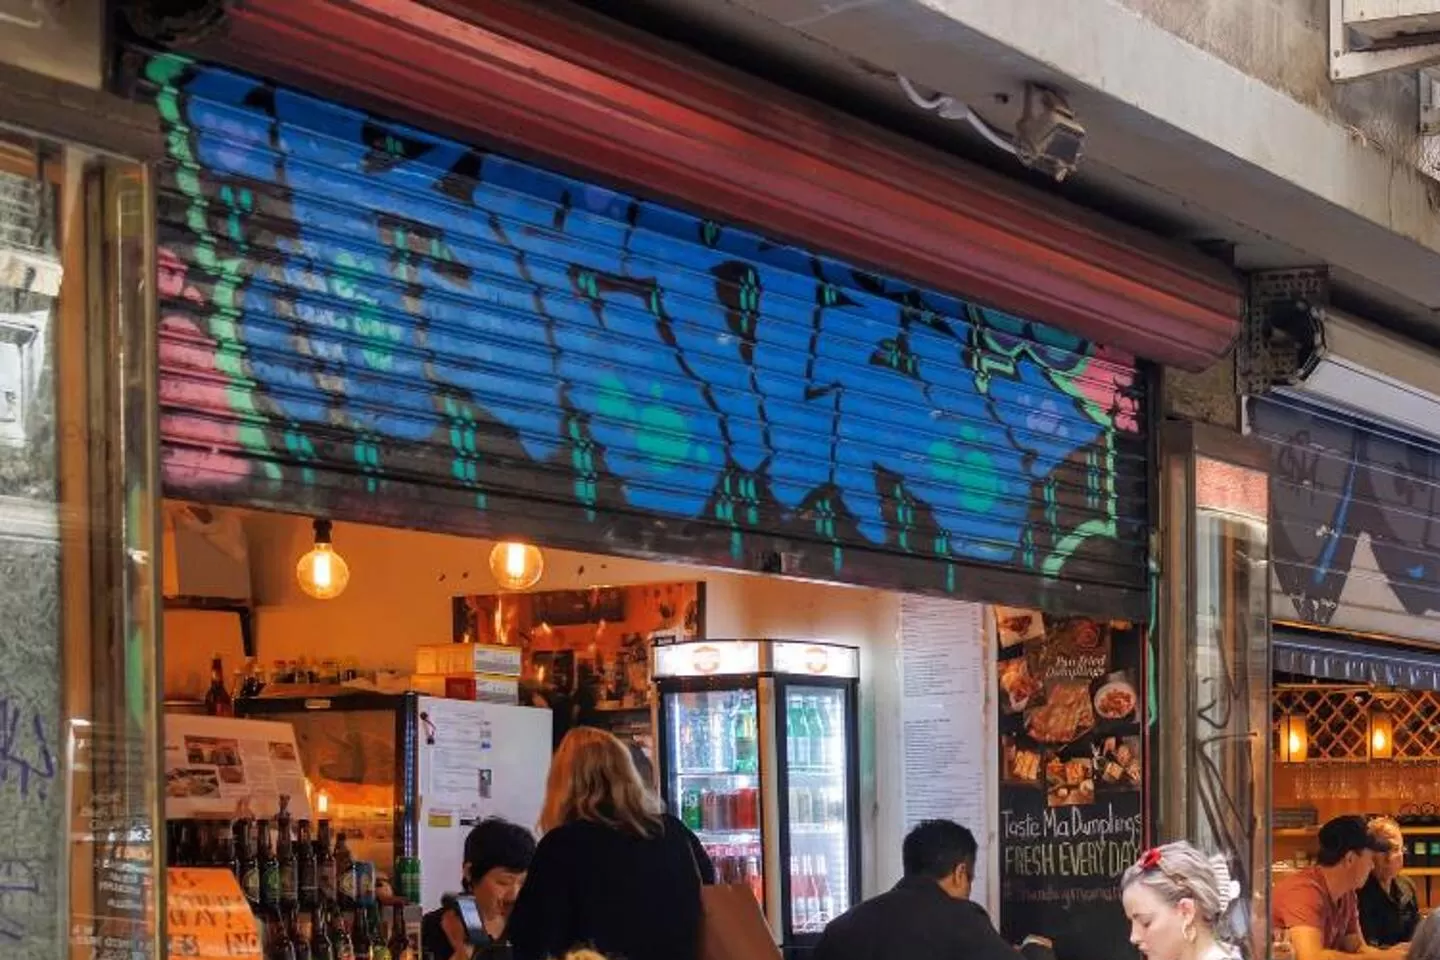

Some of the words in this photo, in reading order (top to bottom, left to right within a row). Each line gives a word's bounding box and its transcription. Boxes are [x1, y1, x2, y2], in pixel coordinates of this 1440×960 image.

[1000, 808, 1041, 838] Taste
[1004, 842, 1056, 877] FRESH
[1058, 841, 1106, 876] EVERY
